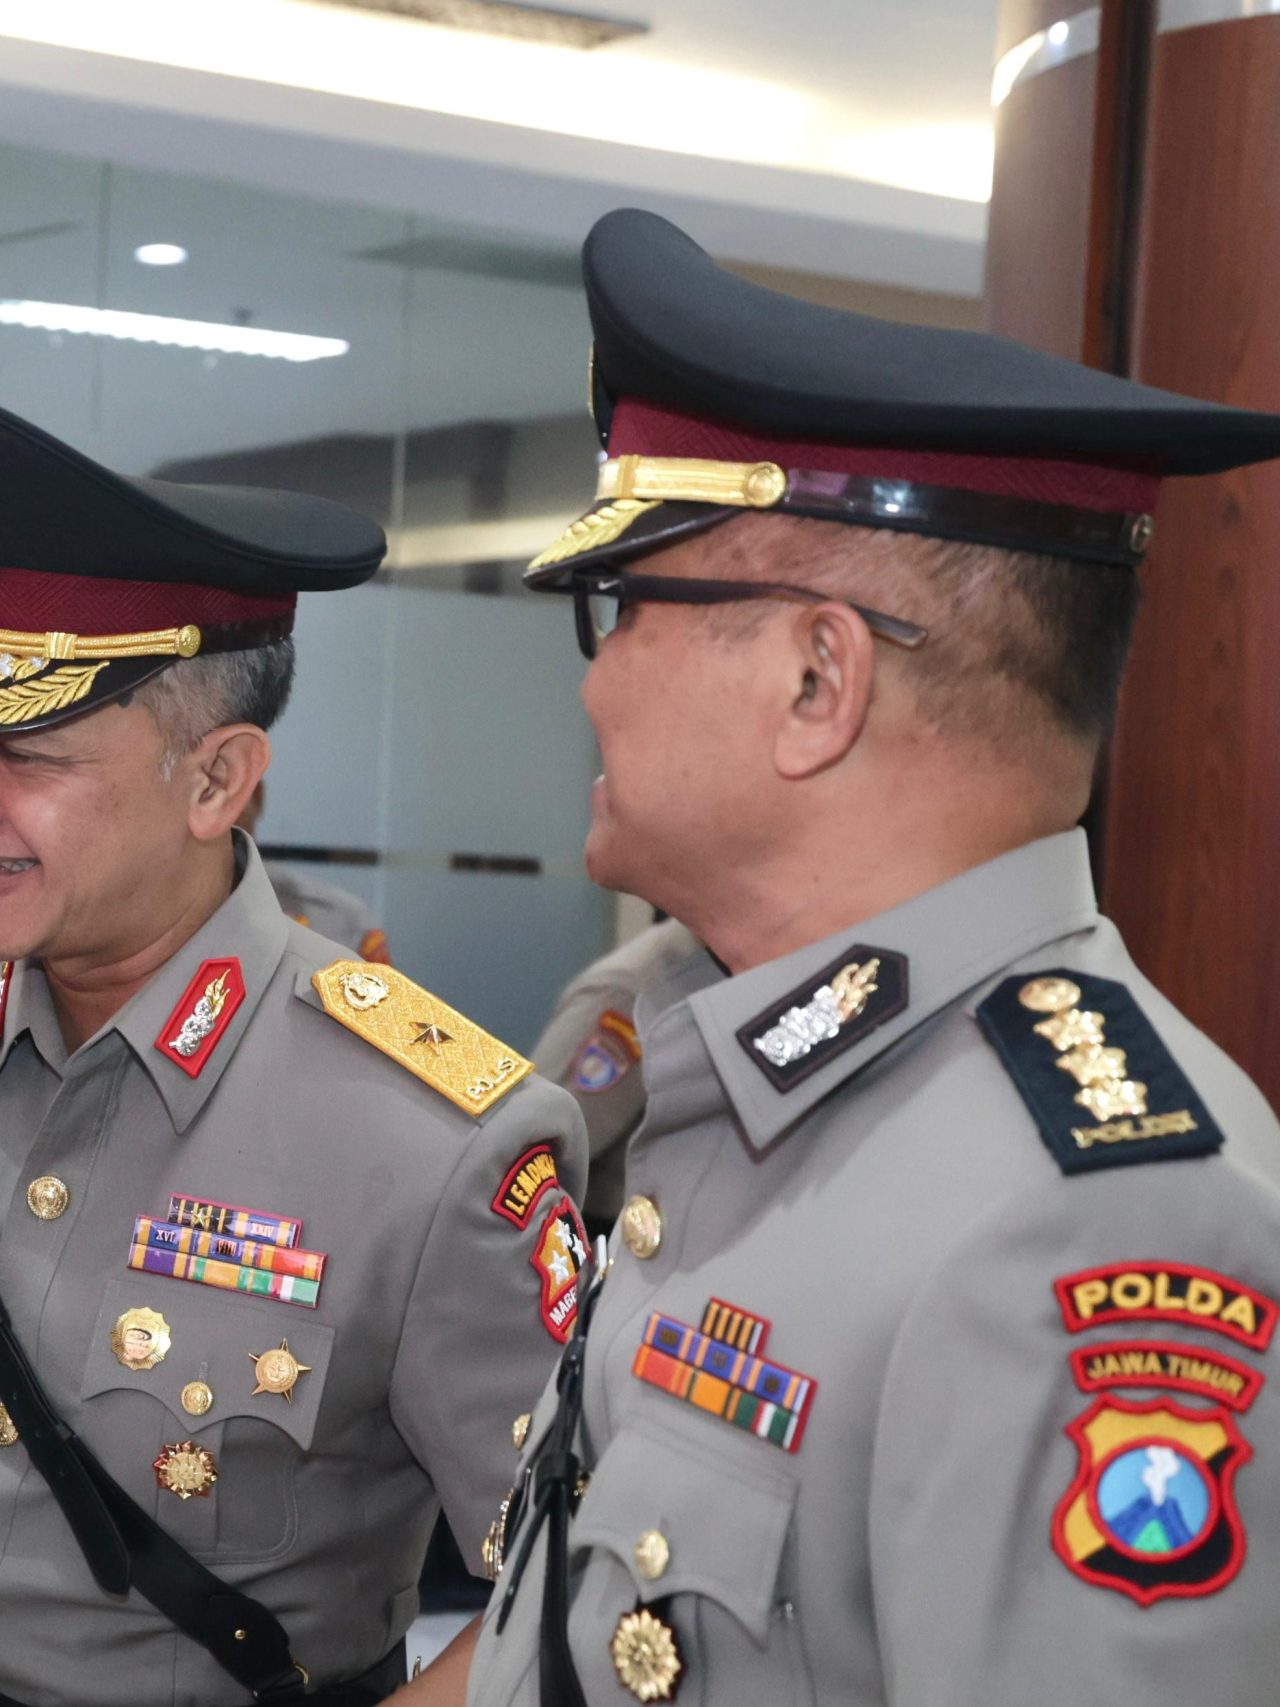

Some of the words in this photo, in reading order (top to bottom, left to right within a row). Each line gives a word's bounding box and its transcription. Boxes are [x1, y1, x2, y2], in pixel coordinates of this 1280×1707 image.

[1073, 1272, 1256, 1334] POLDA
[1087, 1351, 1163, 1380] JAWA
[1166, 1352, 1245, 1398] TIMUR
